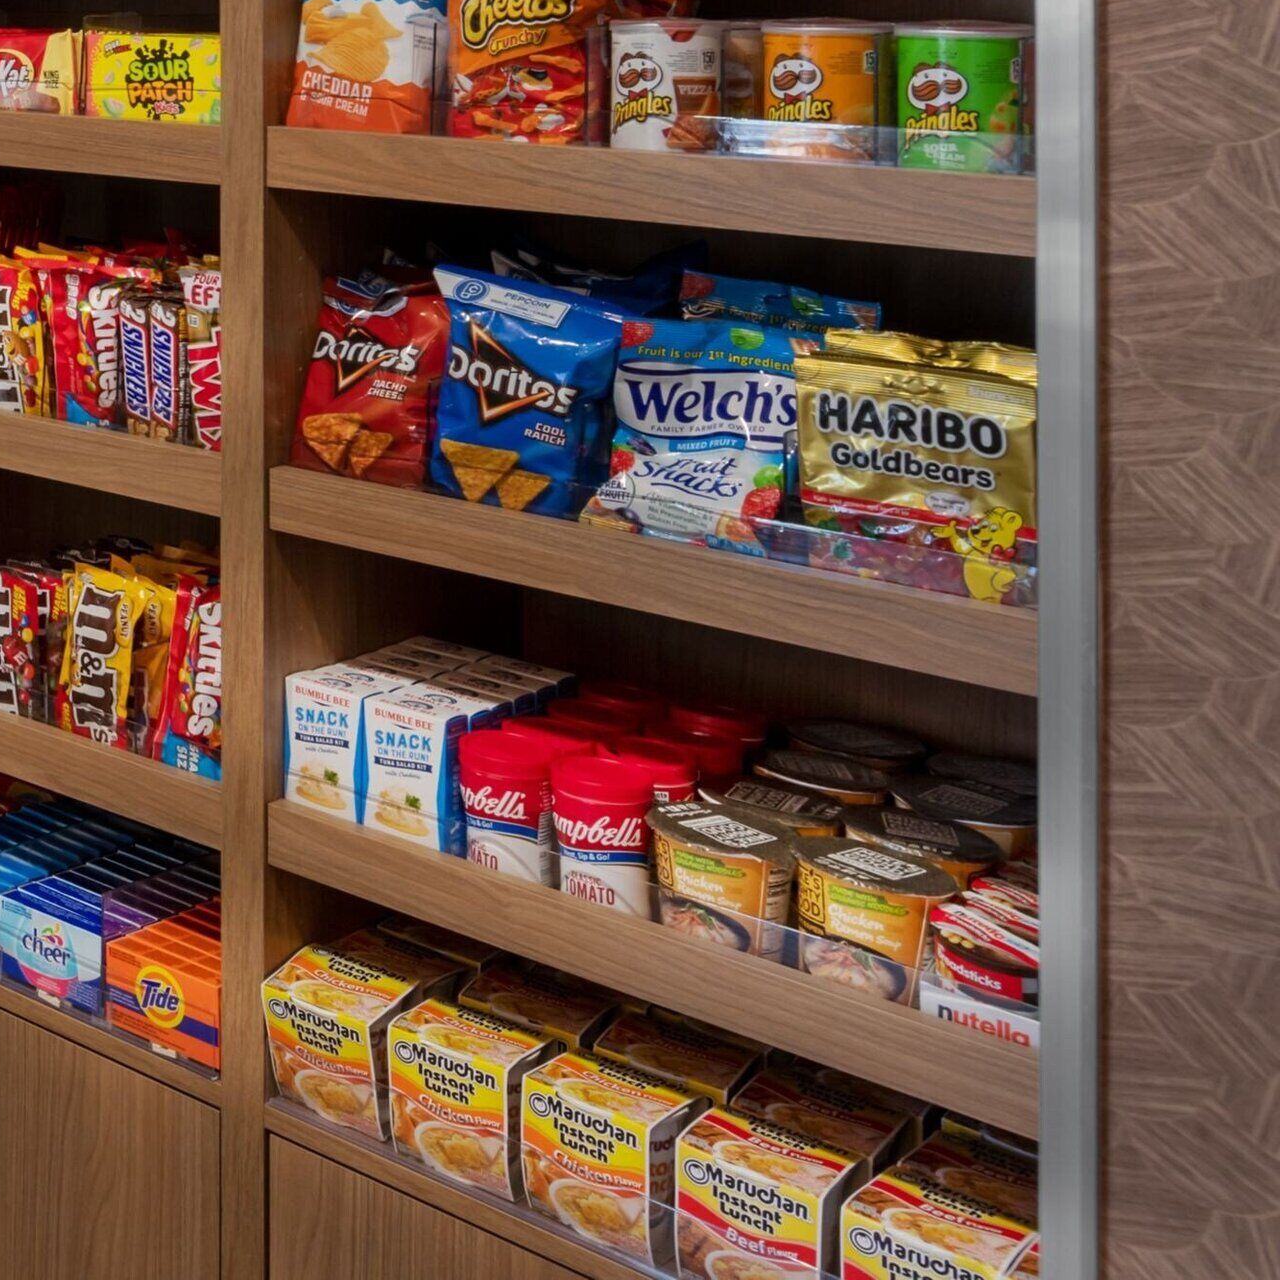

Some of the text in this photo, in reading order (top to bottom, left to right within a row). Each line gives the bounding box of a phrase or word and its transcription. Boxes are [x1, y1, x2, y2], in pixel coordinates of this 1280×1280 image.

[490, 27, 547, 56] Crunchy
[43, 70, 59, 81] KING
[128, 58, 190, 82] SOUR
[127, 80, 193, 104] PATCH
[301, 70, 373, 104] CHEDDAR
[335, 99, 369, 117] CREAM
[613, 92, 673, 132] Pringles
[768, 95, 832, 122] Pringles
[906, 104, 979, 152] Pringles
[505, 291, 550, 310] PEPCOIN
[312, 331, 420, 371] Doritos
[637, 345, 667, 359] Fruit
[683, 349, 704, 360] our
[122, 320, 151, 420] SNICKERS
[372, 378, 408, 392] NACHO
[448, 345, 578, 414] Doritos
[367, 386, 405, 401] CHEESE
[625, 377, 798, 427] Welch's
[524, 428, 566, 447] RANCH
[534, 422, 566, 437] COOL
[650, 423, 685, 433] FAMILY
[817, 391, 1005, 457] HARIBO
[677, 439, 738, 451] MIXED FRUIT
[634, 459, 742, 498] Snacks
[830, 443, 997, 490] Goldbears
[119, 601, 129, 639] PEANUT
[295, 685, 351, 708] BUMBLE BEE
[295, 707, 349, 729] SNACK
[374, 707, 433, 731] BUMBLE BEE
[374, 730, 433, 753] SNACK
[392, 749, 408, 759] THE
[565, 875, 615, 906] TOMATO
[828, 904, 885, 932] Chicken
[22, 927, 71, 966] cheer
[140, 979, 180, 1012] Tide
[284, 1001, 361, 1043] Maruchan
[291, 1018, 344, 1048] Instant
[938, 1004, 1030, 1047] nutella
[296, 1046, 345, 1071] Chicken
[298, 1031, 339, 1056] Lunch
[412, 1044, 496, 1090] Maruchan
[418, 1064, 475, 1096] Instant
[425, 1078, 469, 1106] Lunch
[419, 1093, 474, 1124] Chicken
[549, 1097, 637, 1148] Maruchan
[554, 1118, 616, 1154] Instant
[560, 1135, 609, 1165] Lunch
[554, 1149, 613, 1184] Chicken
[706, 1163, 809, 1220] Maruchan
[712, 1184, 783, 1225] Instant
[719, 1201, 775, 1235] Lunch
[726, 1228, 766, 1253] Beef
[874, 1231, 985, 1280] Maruchan
